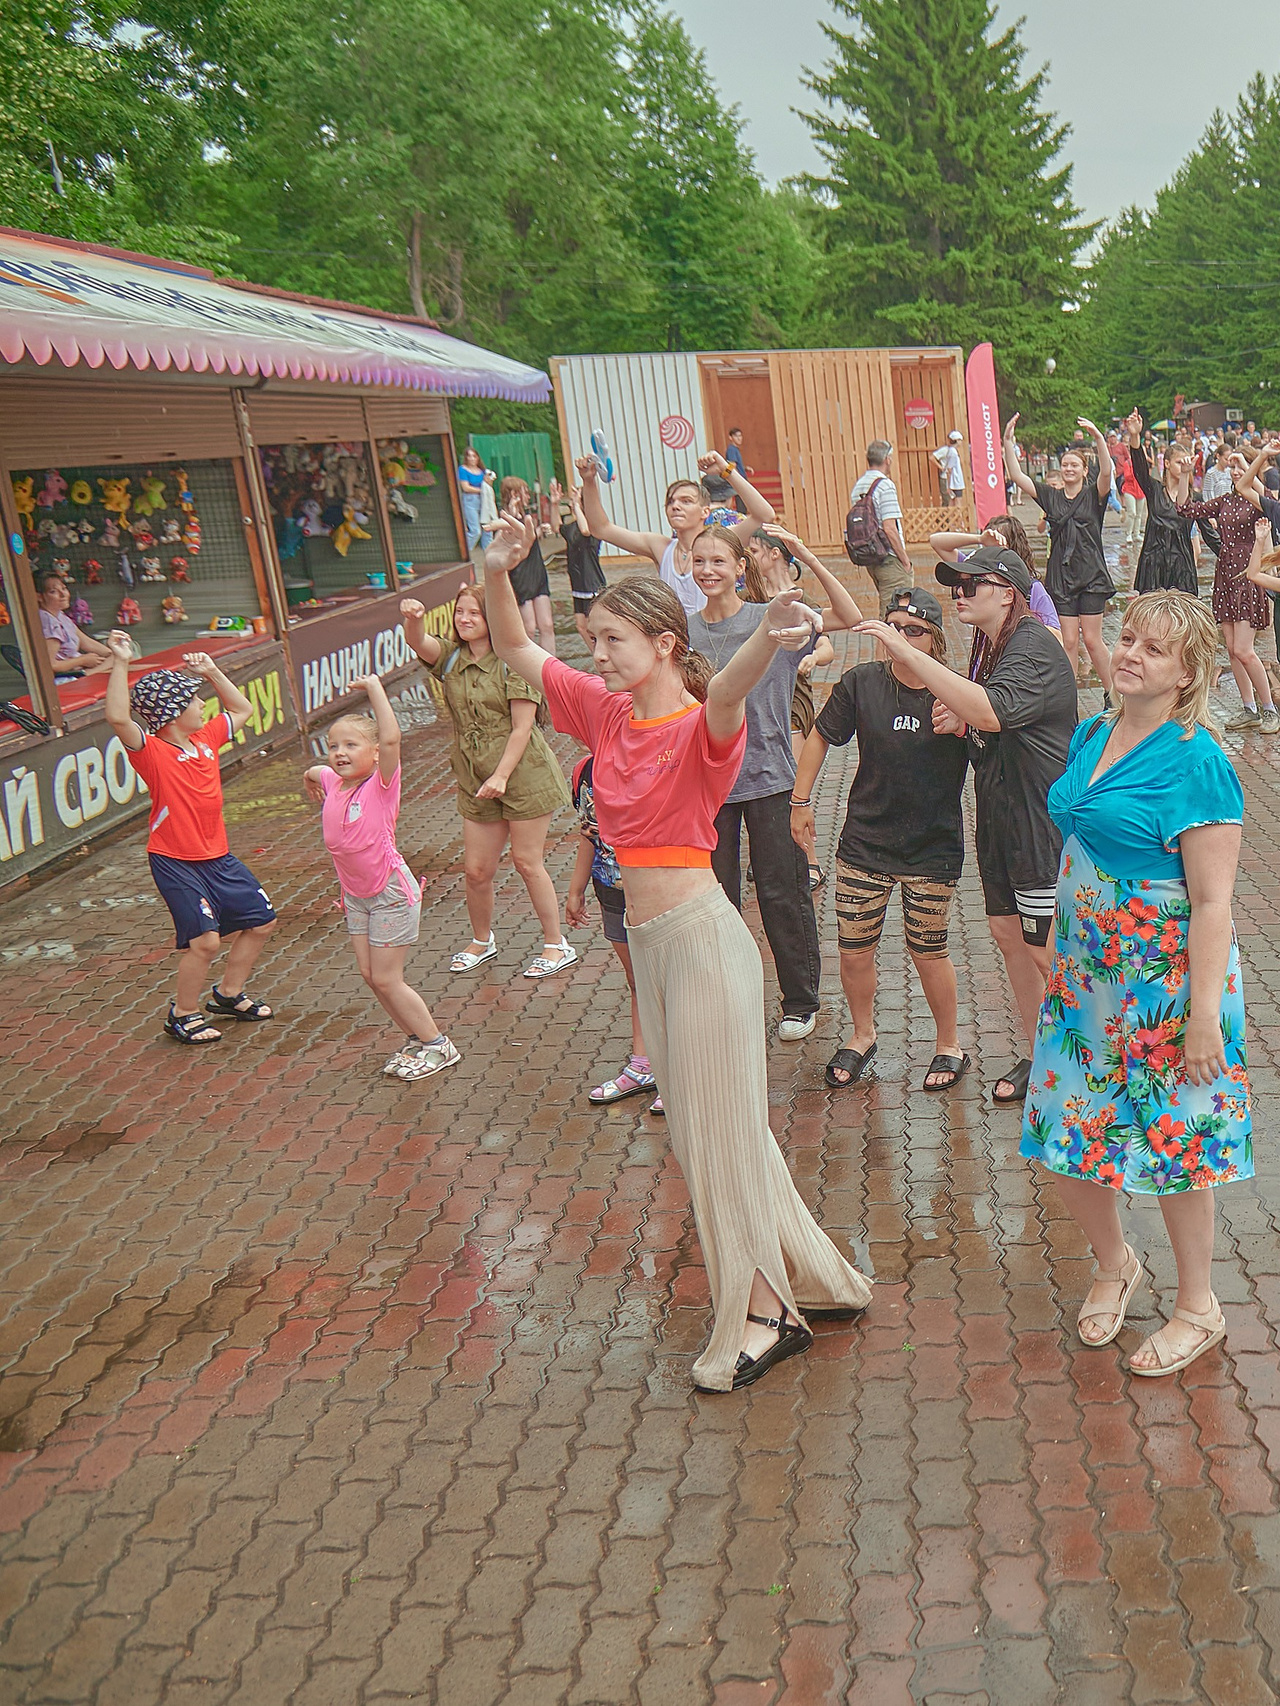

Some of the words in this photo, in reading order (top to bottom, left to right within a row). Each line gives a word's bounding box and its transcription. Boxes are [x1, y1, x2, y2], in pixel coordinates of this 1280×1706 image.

[981, 402, 996, 472] САМОКАТ
[302, 638, 371, 714] НАЧНИ
[893, 715, 920, 733] GAP
[53, 734, 149, 829] СВО
